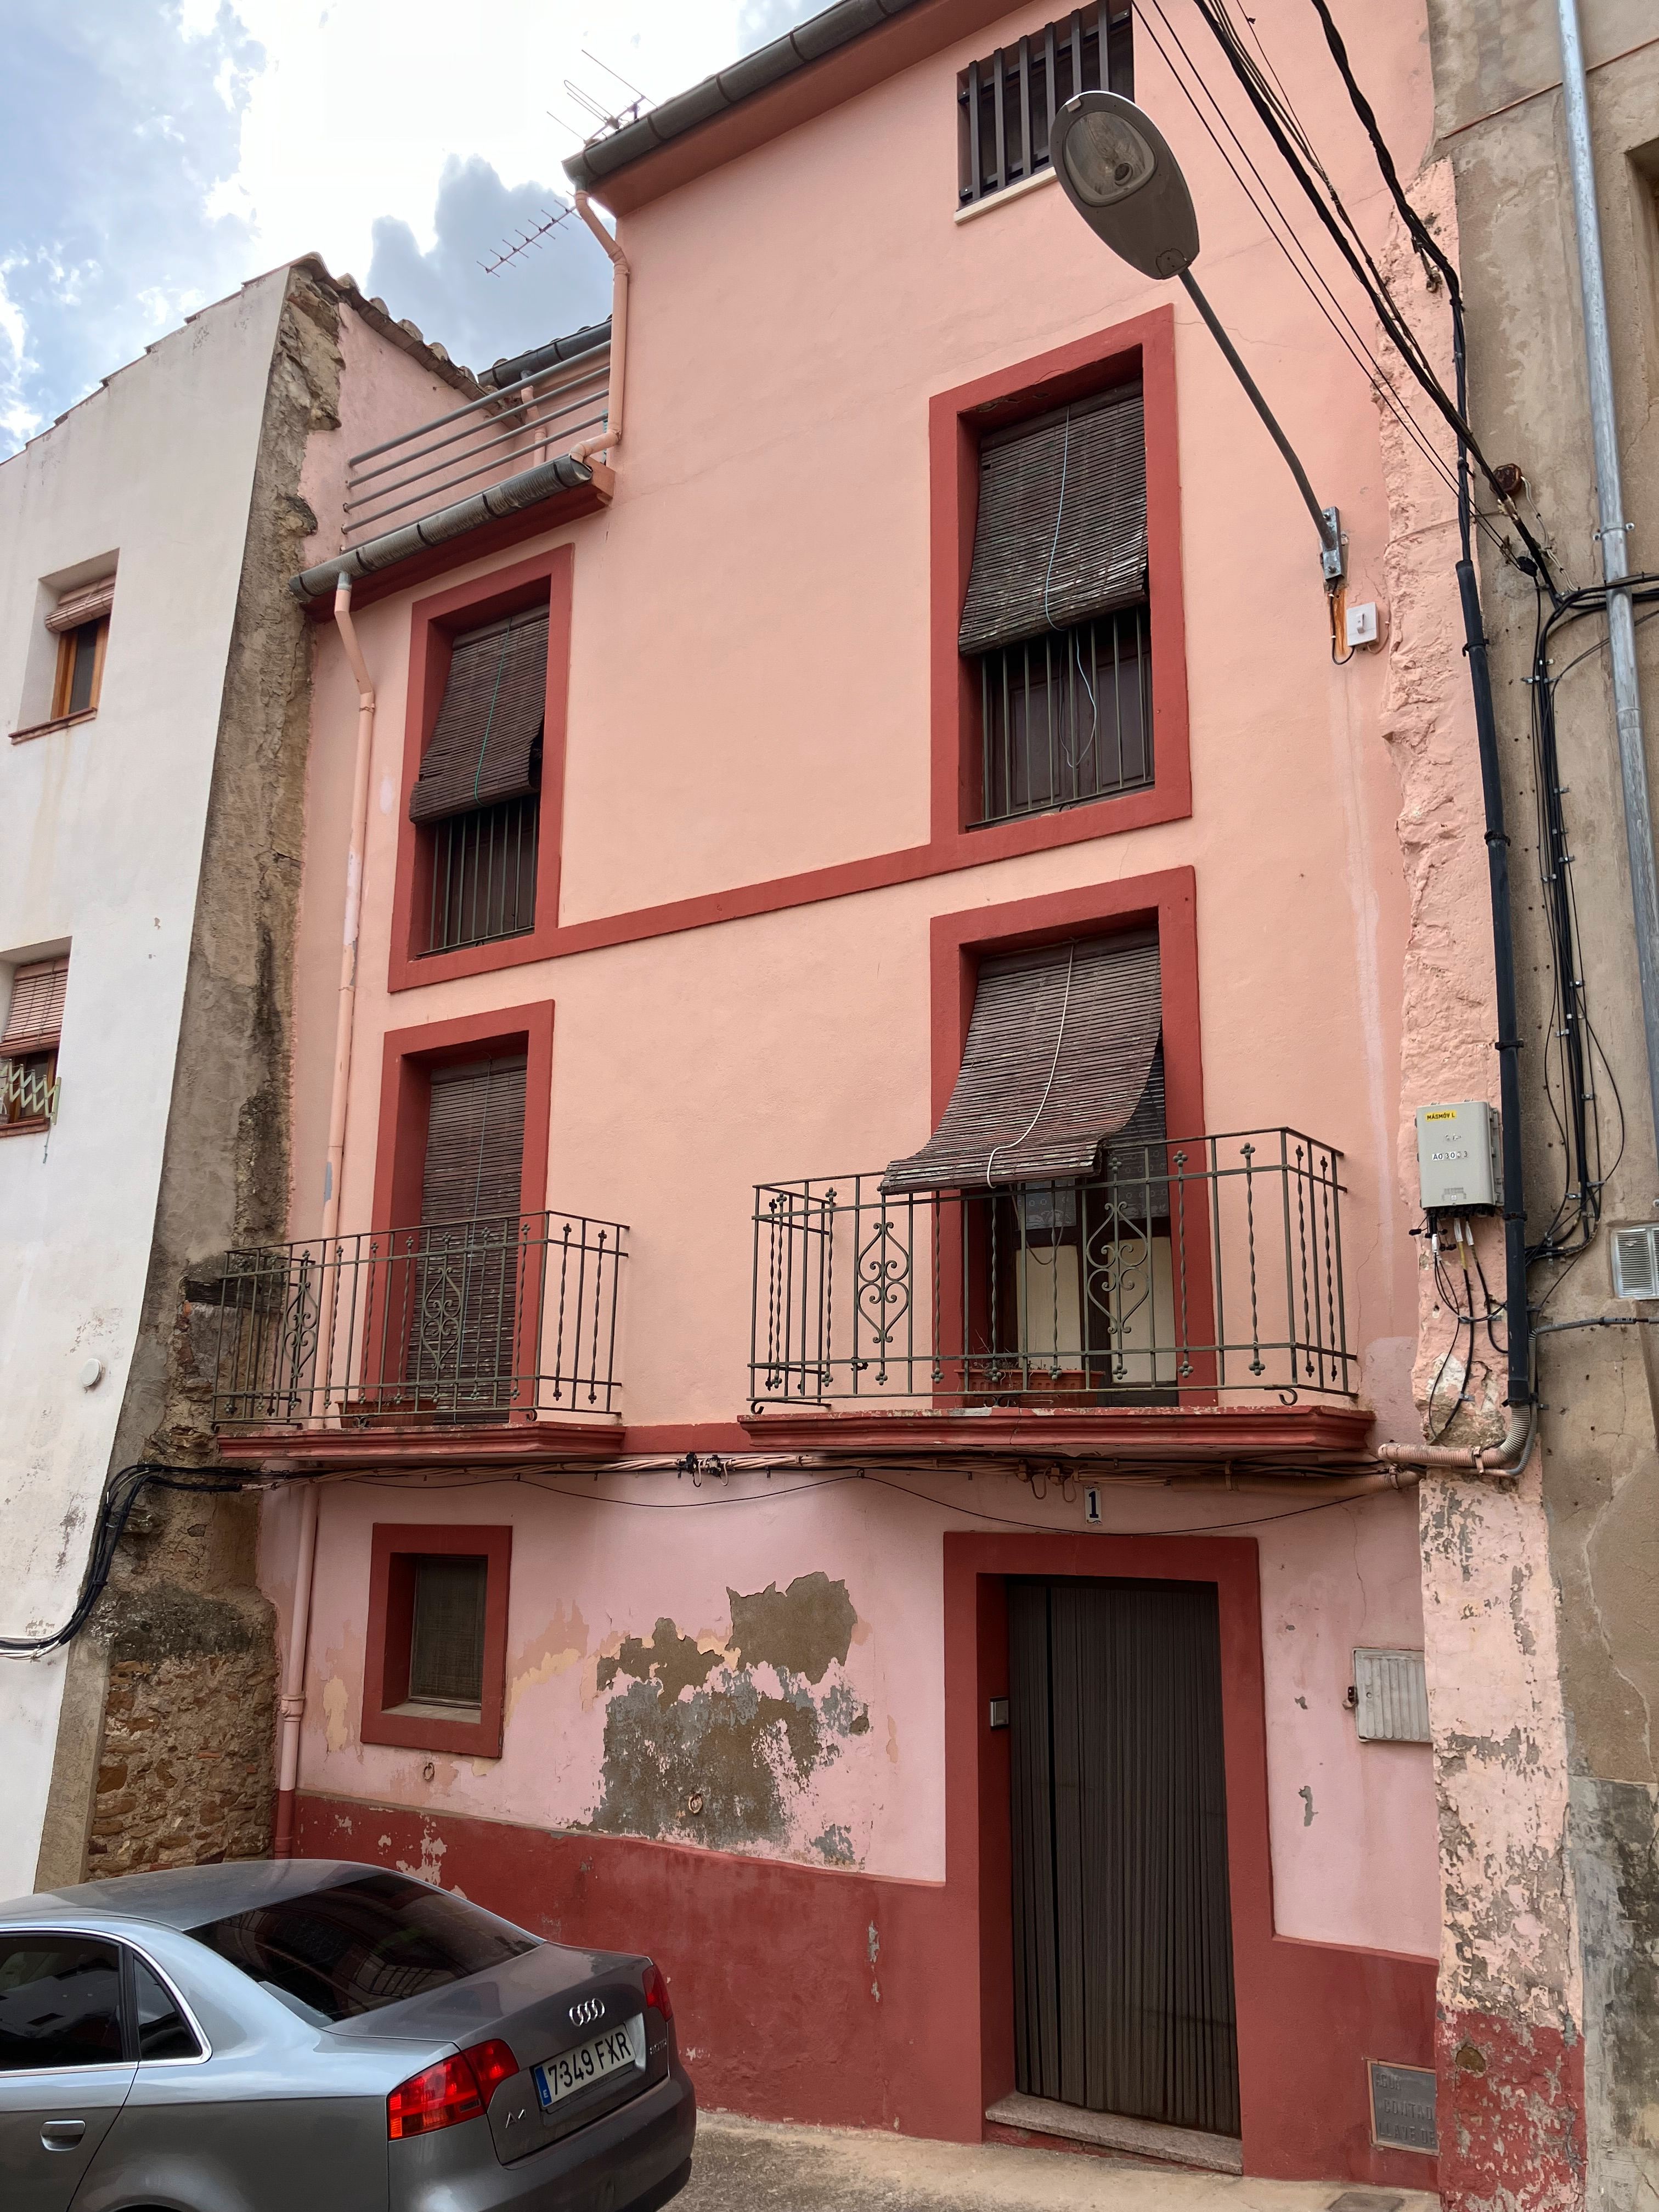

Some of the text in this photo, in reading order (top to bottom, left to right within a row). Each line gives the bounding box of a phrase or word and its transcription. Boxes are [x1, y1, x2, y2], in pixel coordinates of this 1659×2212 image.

[1089, 1491, 1099, 1519] 1
[548, 2049, 594, 2095] 7349
[594, 2032, 631, 2069] FXR
[1376, 2072, 1402, 2090] AGUA
[543, 2089, 549, 2098] E
